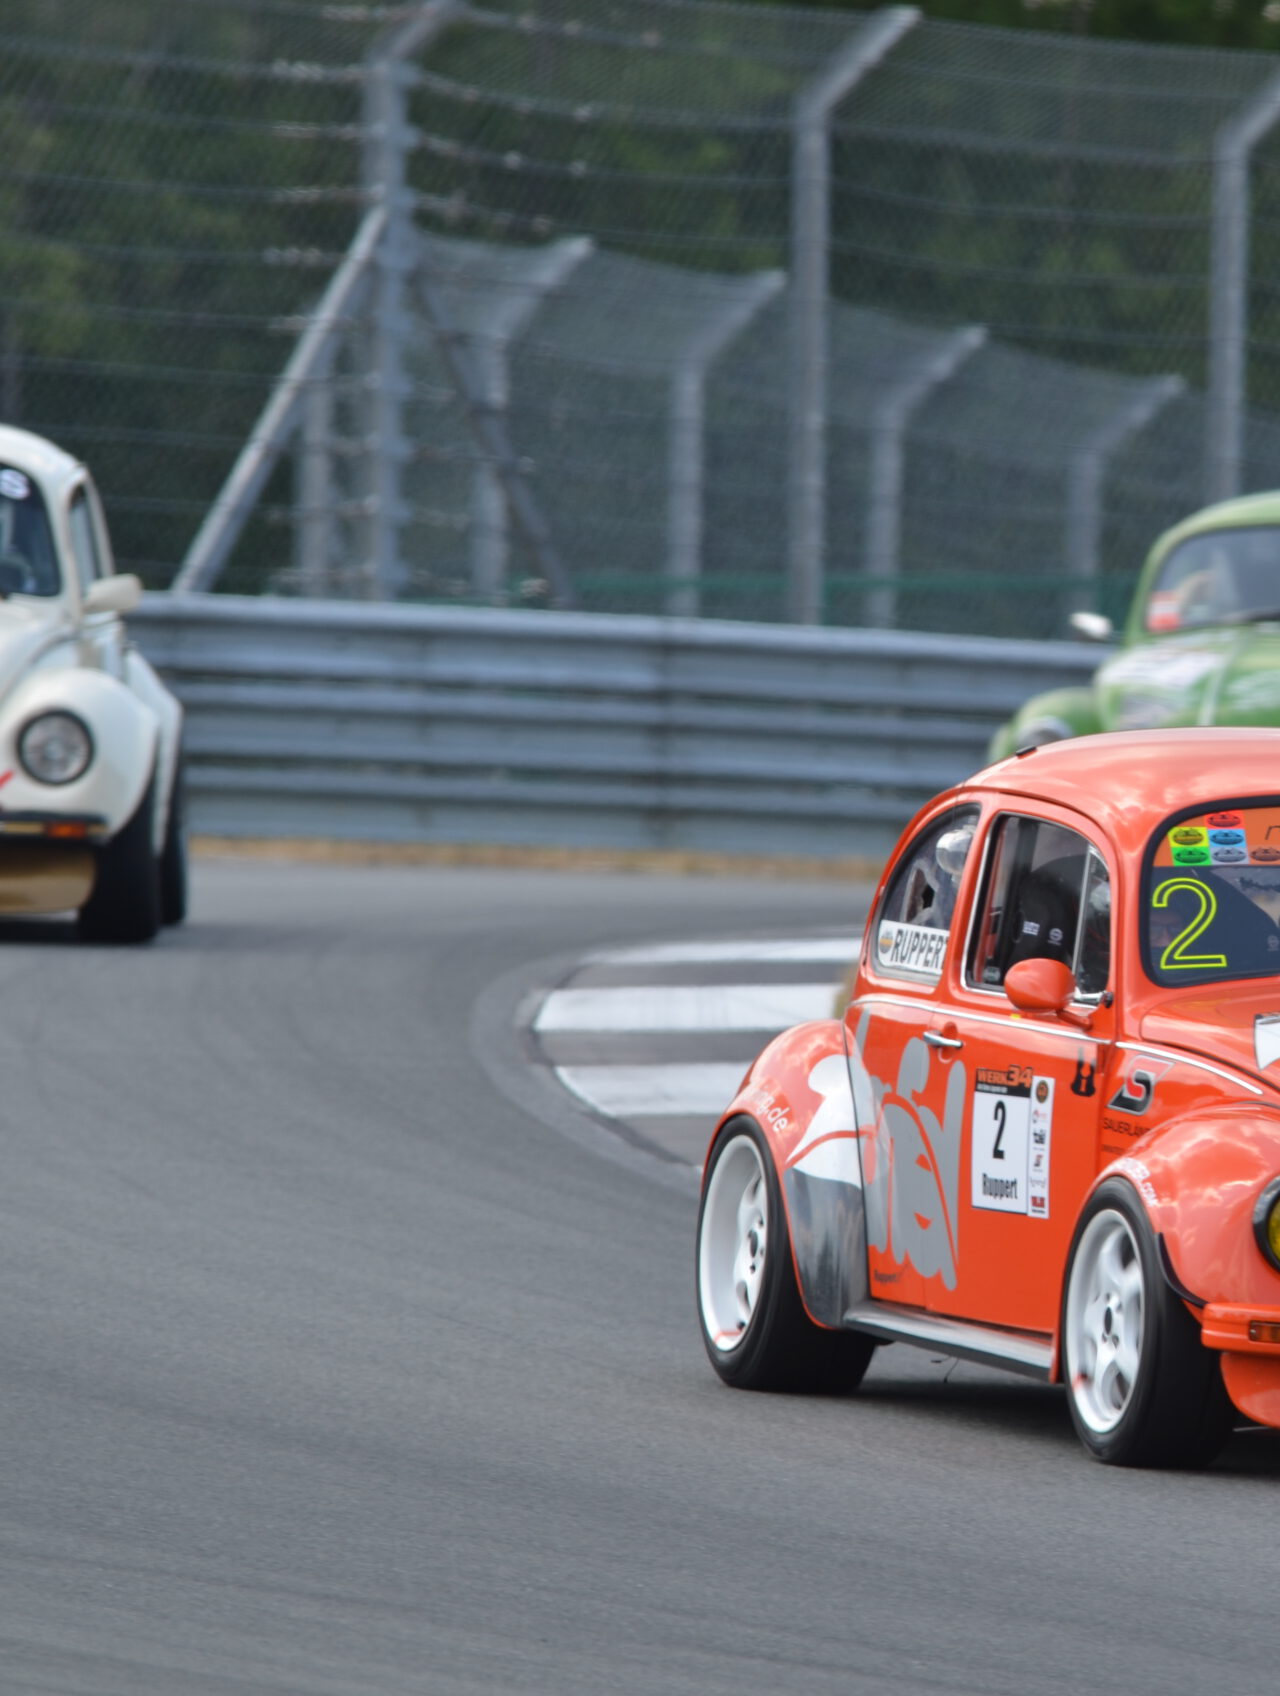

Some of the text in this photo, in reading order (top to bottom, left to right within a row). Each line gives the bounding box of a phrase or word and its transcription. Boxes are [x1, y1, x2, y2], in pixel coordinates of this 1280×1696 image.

[1152, 877, 1228, 970] 2
[993, 1100, 1007, 1160] 2
[981, 1173, 1018, 1199] Ruppert
